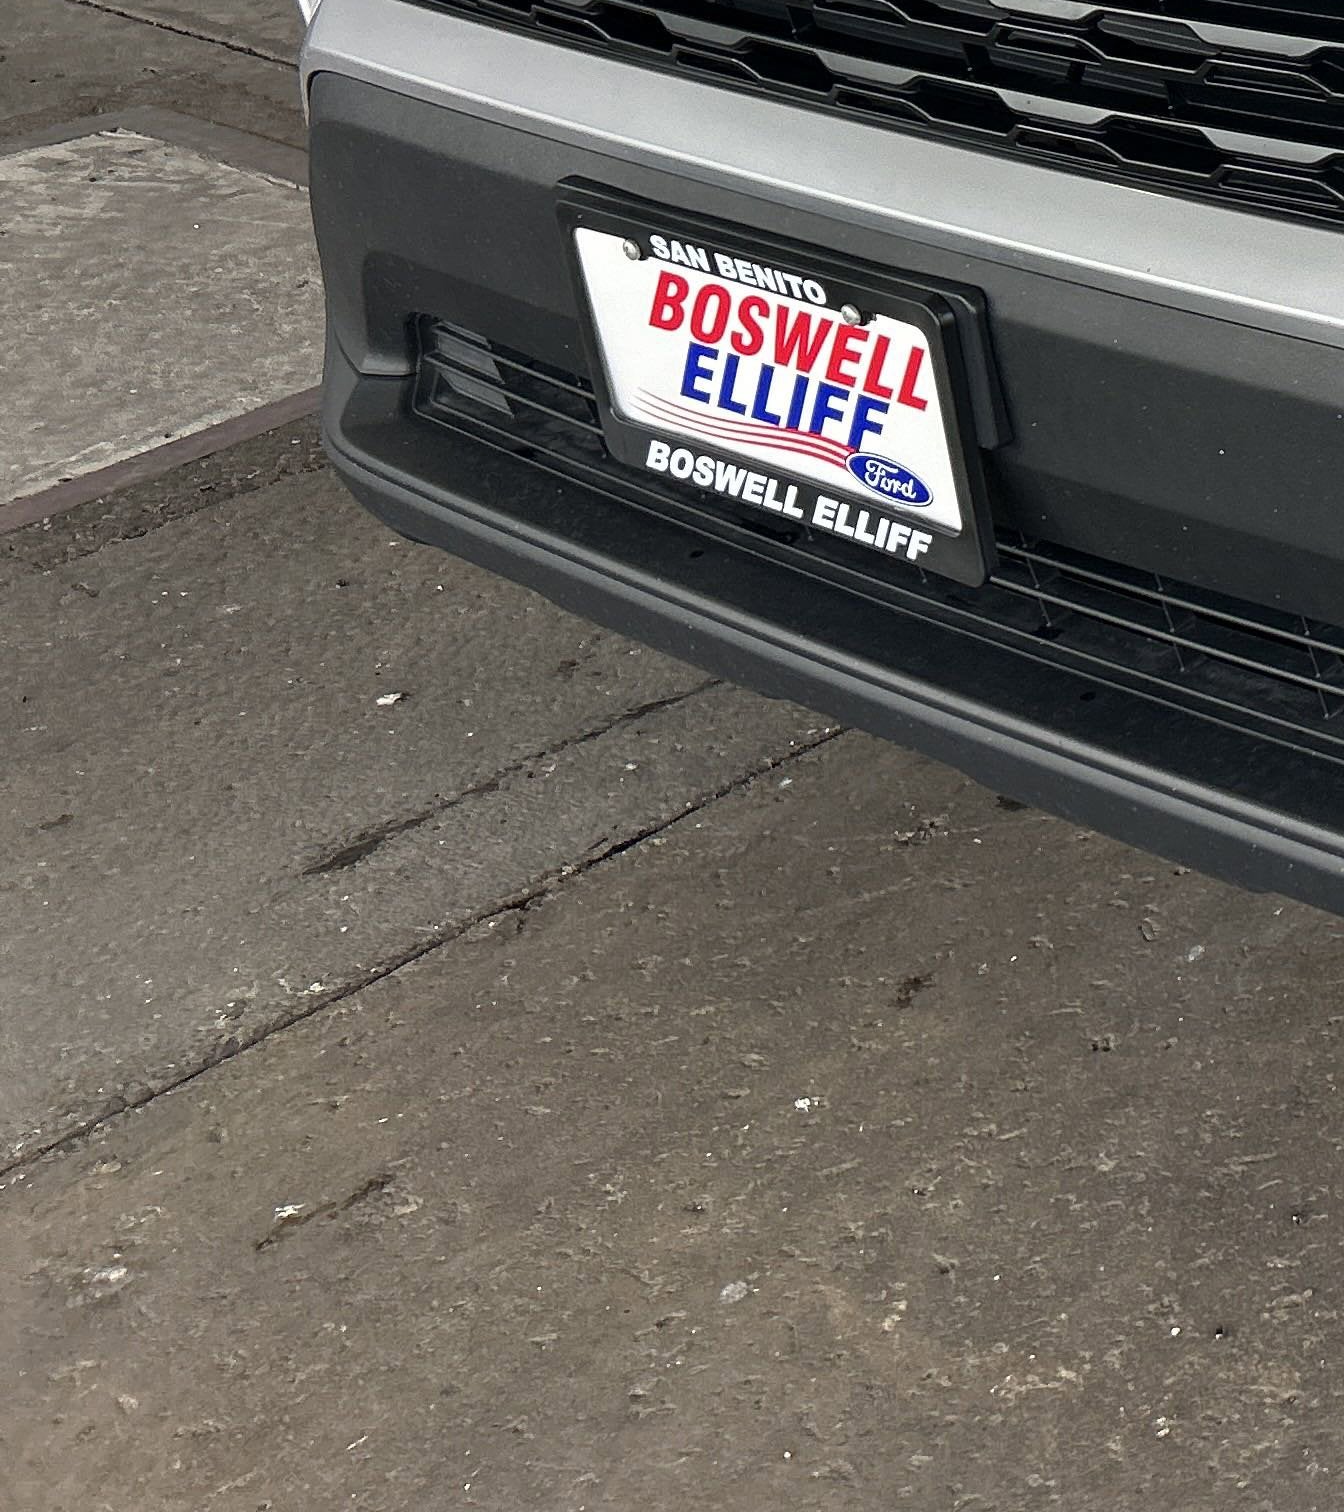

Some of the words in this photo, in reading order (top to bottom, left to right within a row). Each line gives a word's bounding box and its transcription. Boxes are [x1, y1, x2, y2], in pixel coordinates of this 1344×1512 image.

[649, 235, 710, 274] SAN
[714, 252, 827, 305] BENITO
[648, 269, 928, 412] BOSWELL
[680, 341, 890, 452] ELLIFF
[646, 440, 804, 520] BOSWELL
[811, 494, 933, 561] ELLIFF
[864, 459, 917, 499] Ford
